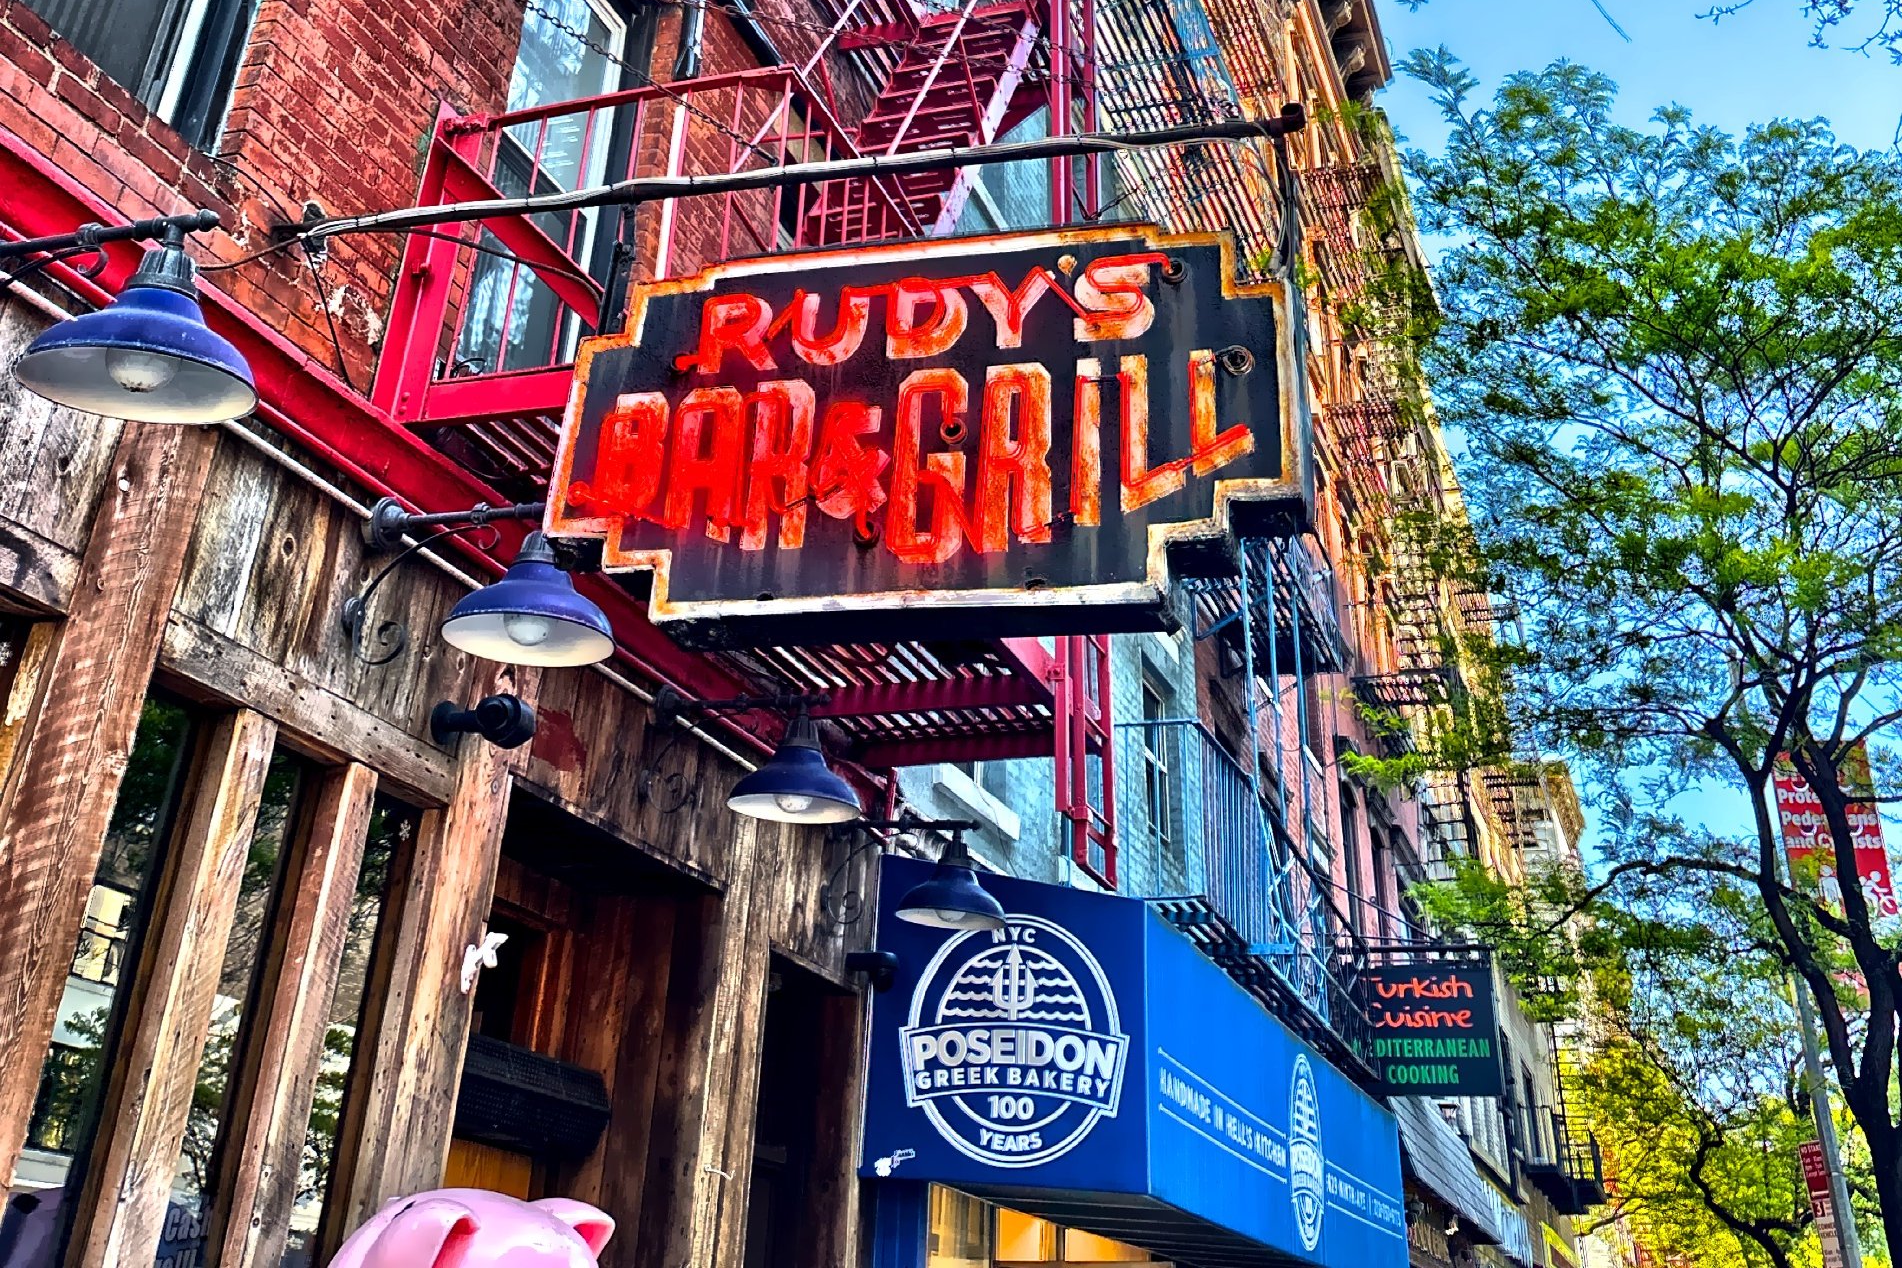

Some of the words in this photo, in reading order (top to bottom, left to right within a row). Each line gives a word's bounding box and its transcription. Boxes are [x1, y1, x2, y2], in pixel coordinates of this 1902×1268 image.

[694, 251, 1157, 374] RUDY'S
[1780, 810, 1878, 826] Pedeans
[1785, 834, 1816, 849] and
[1817, 833, 1883, 851] Cists
[991, 926, 1037, 944] NYC
[910, 1029, 1118, 1080] POSEIDON
[1351, 1037, 1491, 1058] MDITERRANEAN
[914, 1067, 1000, 1090] GREEK
[1006, 1067, 1111, 1098] BAKERY
[1387, 1064, 1460, 1085] COOKING
[987, 1095, 1035, 1120] 100
[1159, 1066, 1212, 1124] HANDMADE
[1213, 1104, 1224, 1132] IN
[1225, 1113, 1253, 1150] HELL'S
[1253, 1131, 1287, 1169] KITCHEN
[979, 1128, 1043, 1152] YEARS
